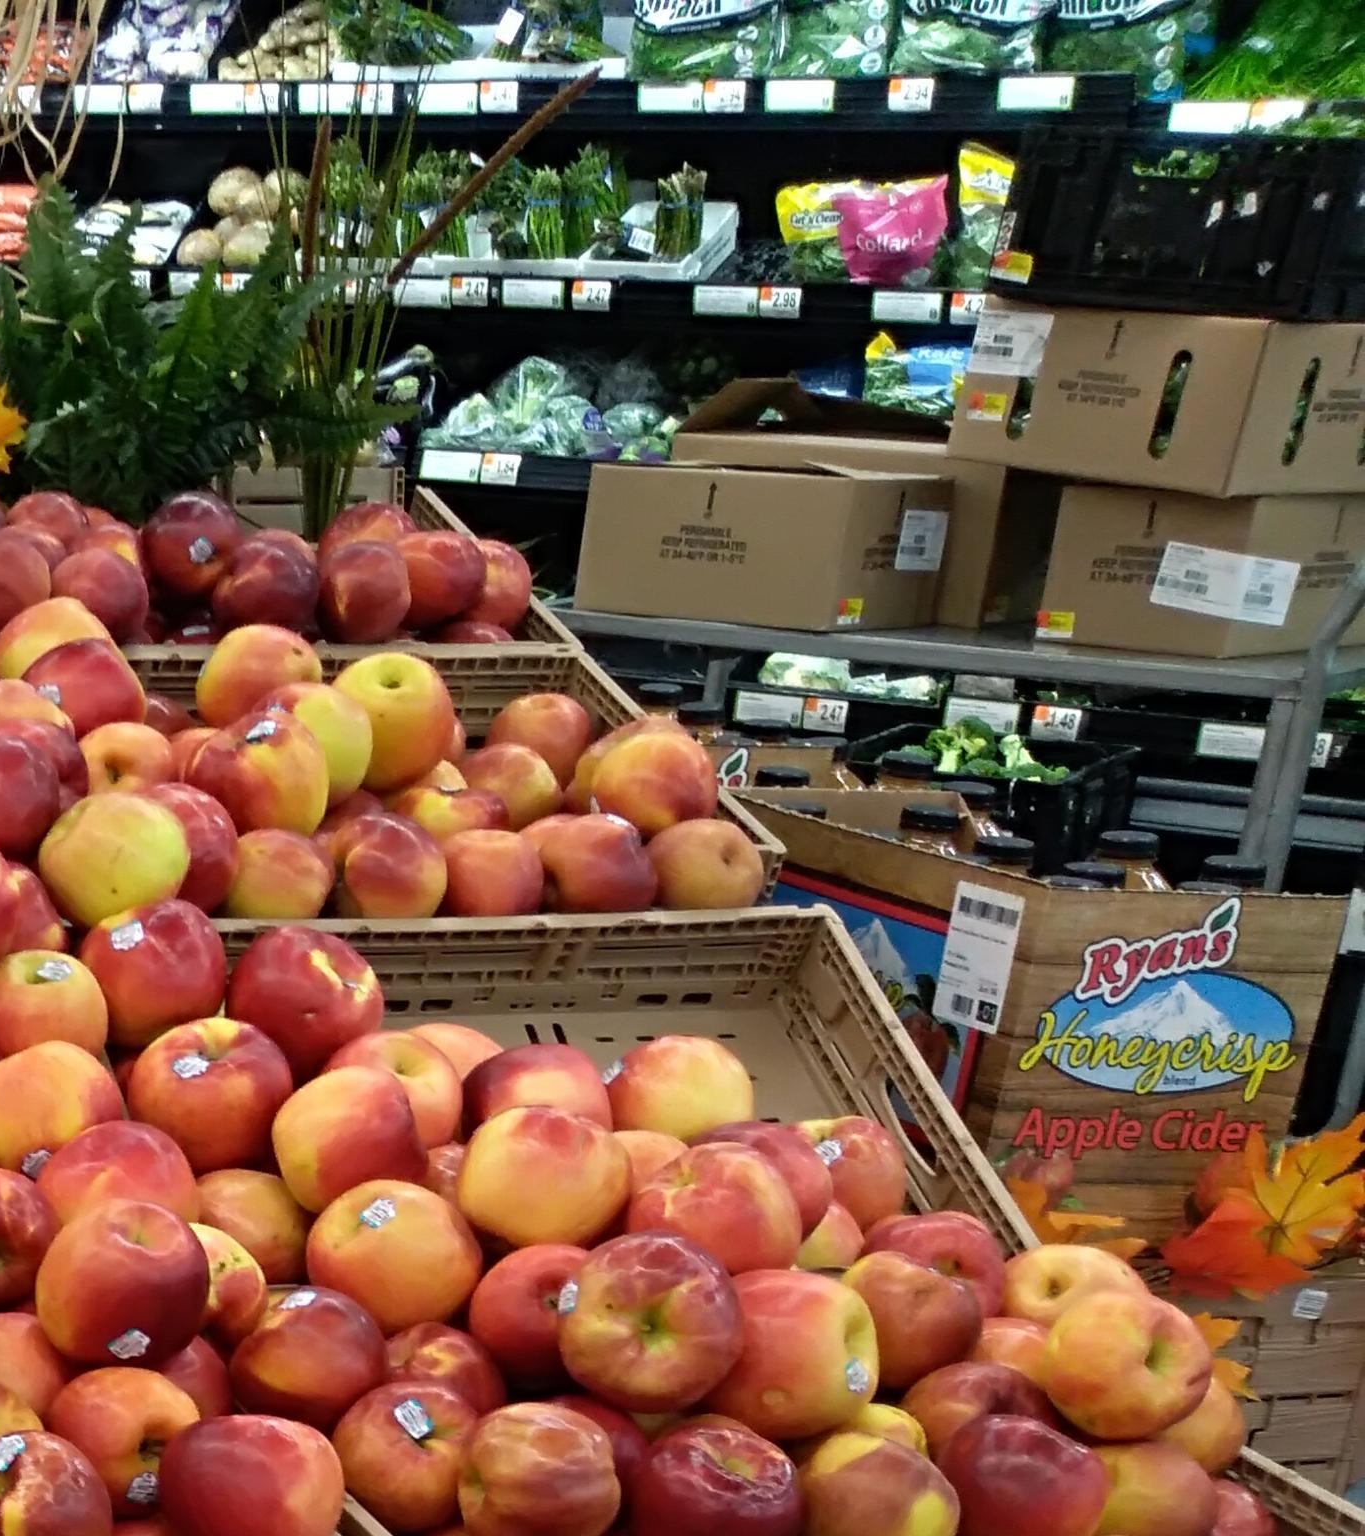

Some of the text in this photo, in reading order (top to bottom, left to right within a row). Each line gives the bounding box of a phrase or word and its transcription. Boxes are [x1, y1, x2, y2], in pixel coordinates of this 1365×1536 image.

[855, 229, 923, 251] Collard
[772, 292, 797, 309] 2.98
[820, 704, 844, 722] 2.47
[1080, 930, 1231, 998] Ryans
[1019, 1008, 1297, 1103] Honeycrisp
[1163, 1075, 1197, 1087] blend
[1013, 1107, 1143, 1159] Apple
